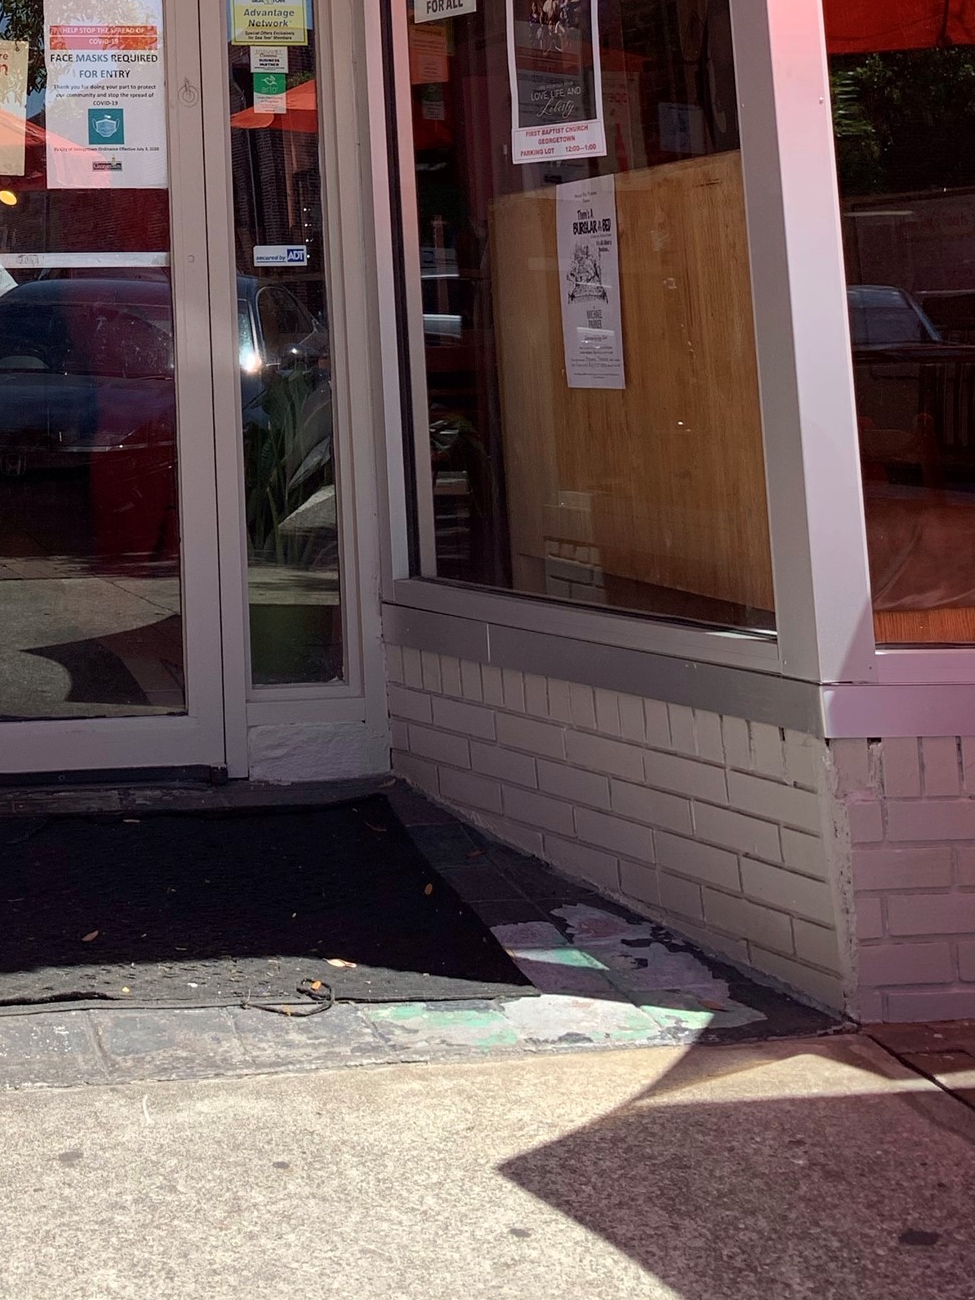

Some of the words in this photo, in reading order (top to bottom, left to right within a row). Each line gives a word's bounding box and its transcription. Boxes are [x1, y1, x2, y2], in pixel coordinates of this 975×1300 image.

[244, 8, 295, 18] Advantage
[50, 54, 73, 62] FACE
[75, 54, 108, 62] MASKS
[111, 54, 158, 63] REQUIRED
[79, 70, 98, 78] FOR
[101, 70, 131, 78] ENTRY
[567, 87, 581, 95] AND
[565, 125, 588, 133] CHURCH
[538, 136, 575, 145] GEORGETOWN
[521, 149, 543, 157] PARKING
[287, 251, 304, 260] ADT
